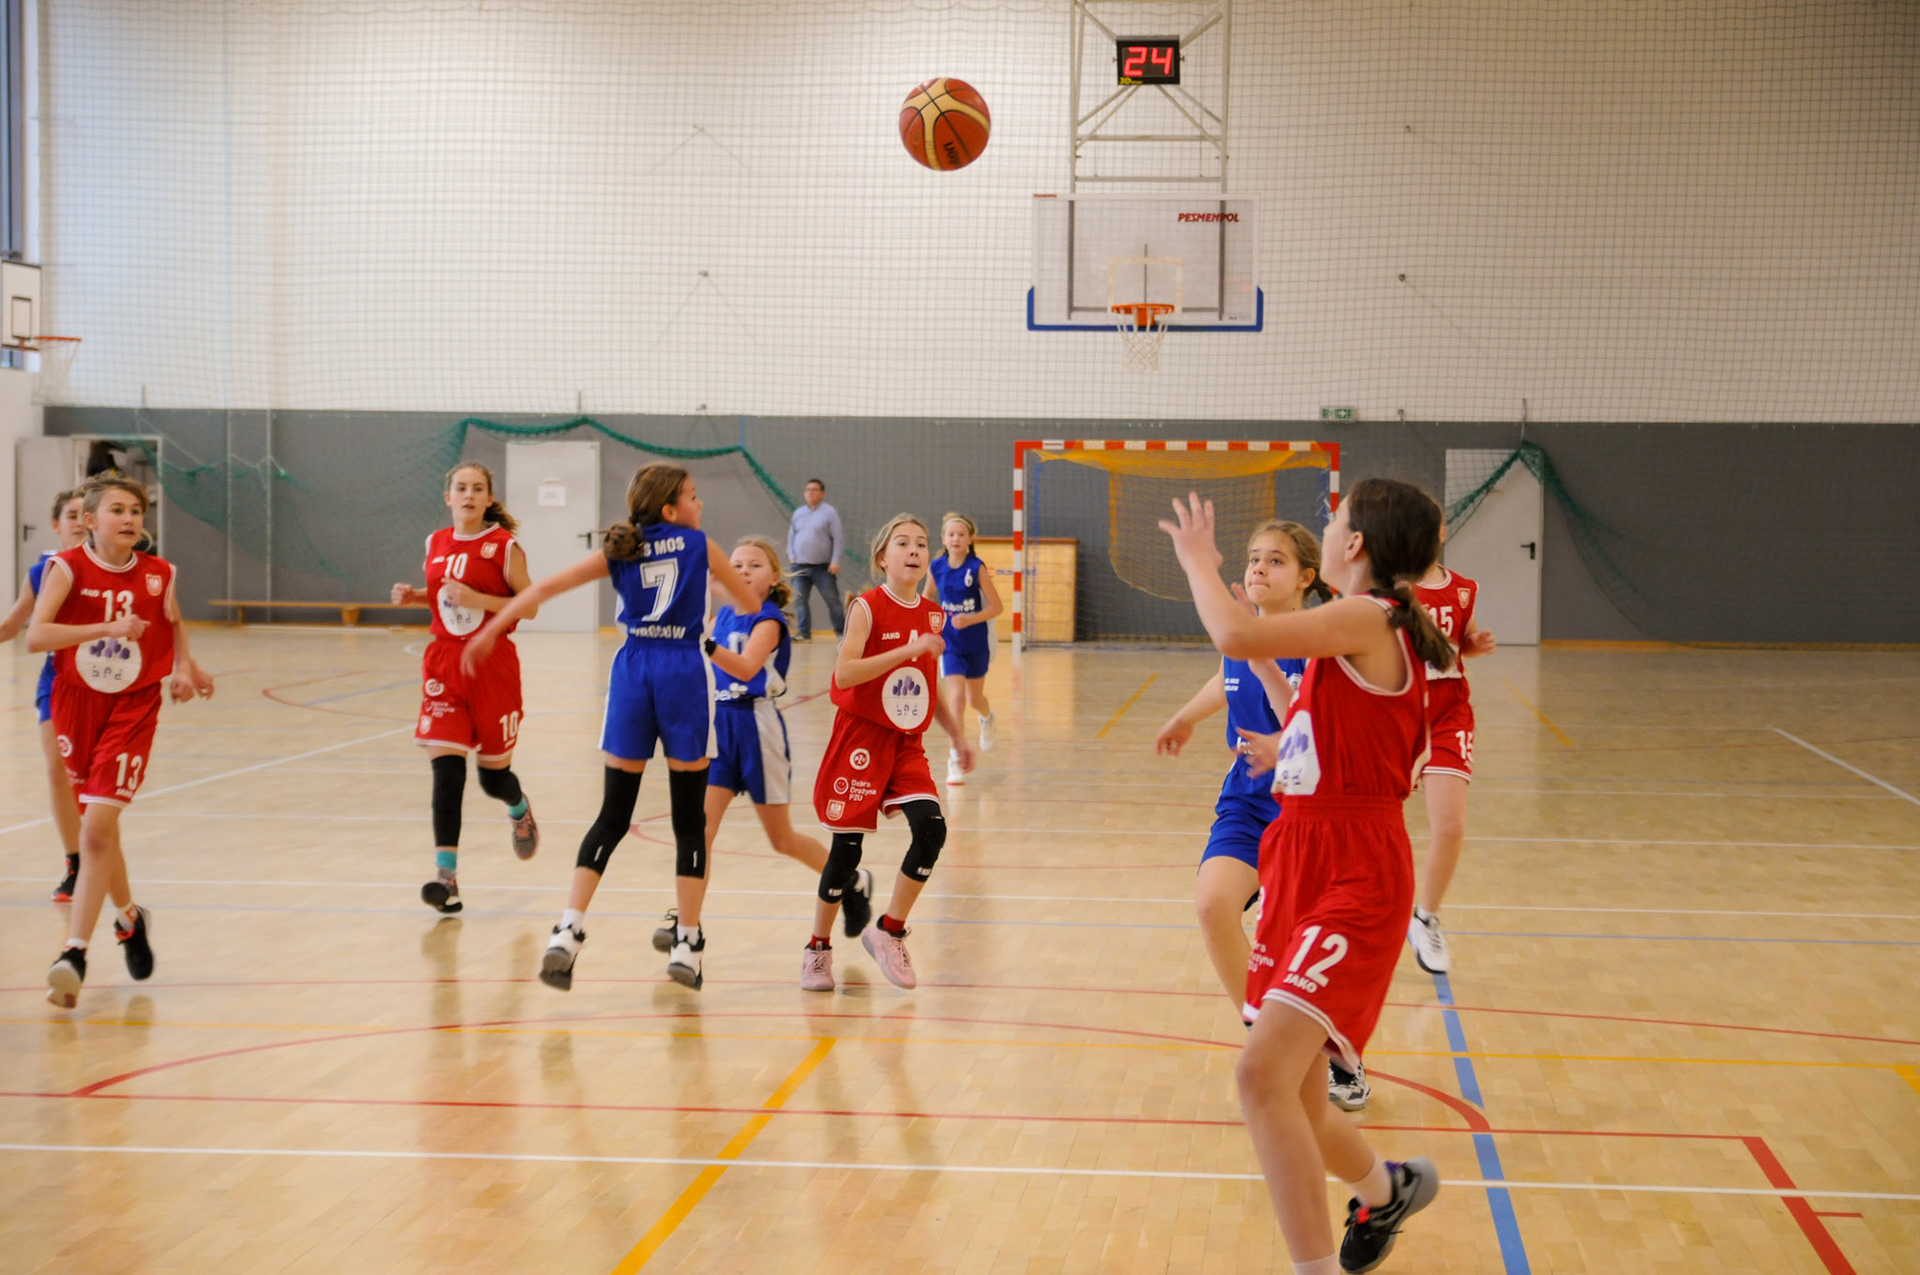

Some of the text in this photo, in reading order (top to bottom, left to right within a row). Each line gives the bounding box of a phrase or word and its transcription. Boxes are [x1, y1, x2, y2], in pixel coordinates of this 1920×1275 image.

[1124, 46, 1173, 77] 24
[1178, 212, 1240, 223] PESMENPOL
[654, 536, 685, 556] MOS
[445, 552, 468, 580] 10
[964, 568, 973, 588] 6
[639, 557, 680, 622] 7
[102, 589, 134, 623] 13
[1428, 605, 1453, 638] 15
[881, 632, 900, 641] JAKO
[499, 710, 519, 742] 10
[116, 752, 143, 791] 13
[1288, 925, 1348, 987] 12
[1283, 973, 1318, 993] JAKO
